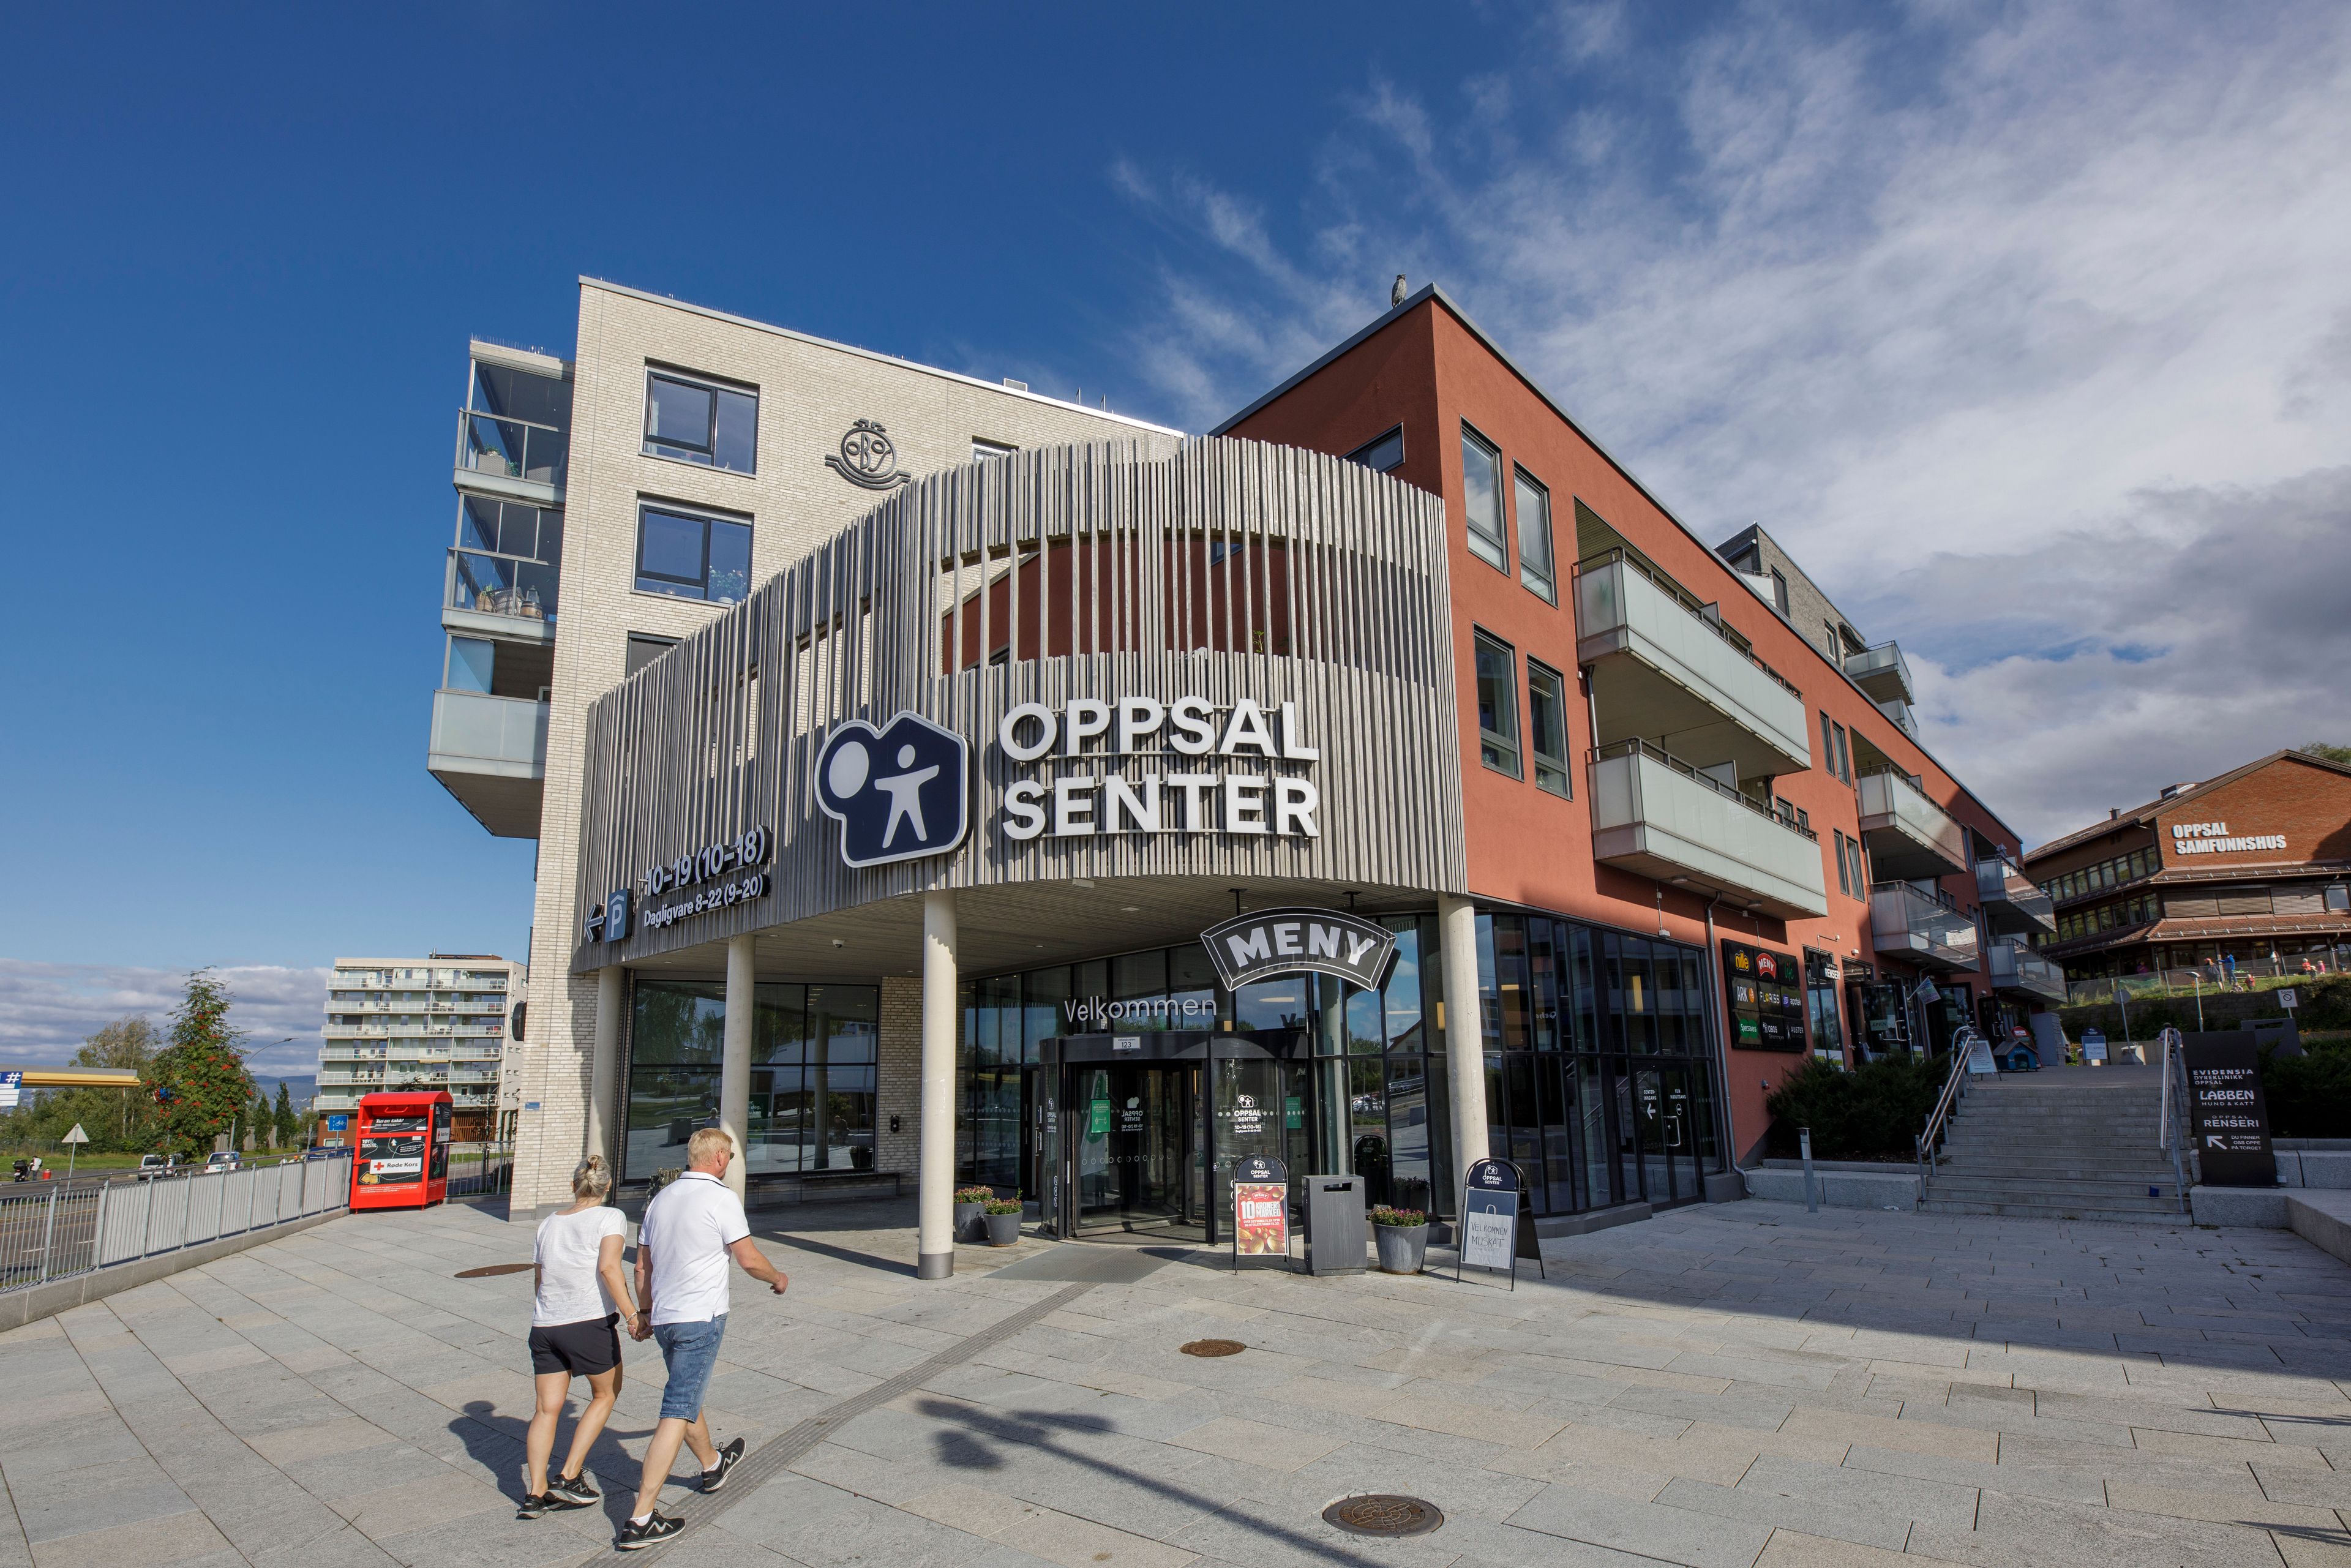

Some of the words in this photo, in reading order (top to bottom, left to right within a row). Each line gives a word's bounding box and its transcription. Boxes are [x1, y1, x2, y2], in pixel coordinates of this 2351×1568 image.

[999, 696, 1320, 762] OPPSAL
[1002, 774, 1320, 840] SENTER
[2173, 822, 2229, 838] OPPSAL
[2175, 835, 2287, 854] SAMFUNNSHUS
[610, 904, 622, 937] P
[644, 901, 694, 928] Dagligvare
[1226, 923, 1376, 967] MENY
[1735, 951, 1749, 970] nille
[1758, 958, 1774, 972] MENY
[1737, 986, 1748, 1002] ARK
[1064, 996, 1217, 1022] Velkommen
[2199, 1090, 2254, 1100] LABBEN
[1241, 1201, 1256, 1220] 10
[1256, 1209, 1281, 1218] MARKED
[1471, 1221, 1508, 1236] VELKOMMEN
[1471, 1235, 1505, 1248] MUSKAT
